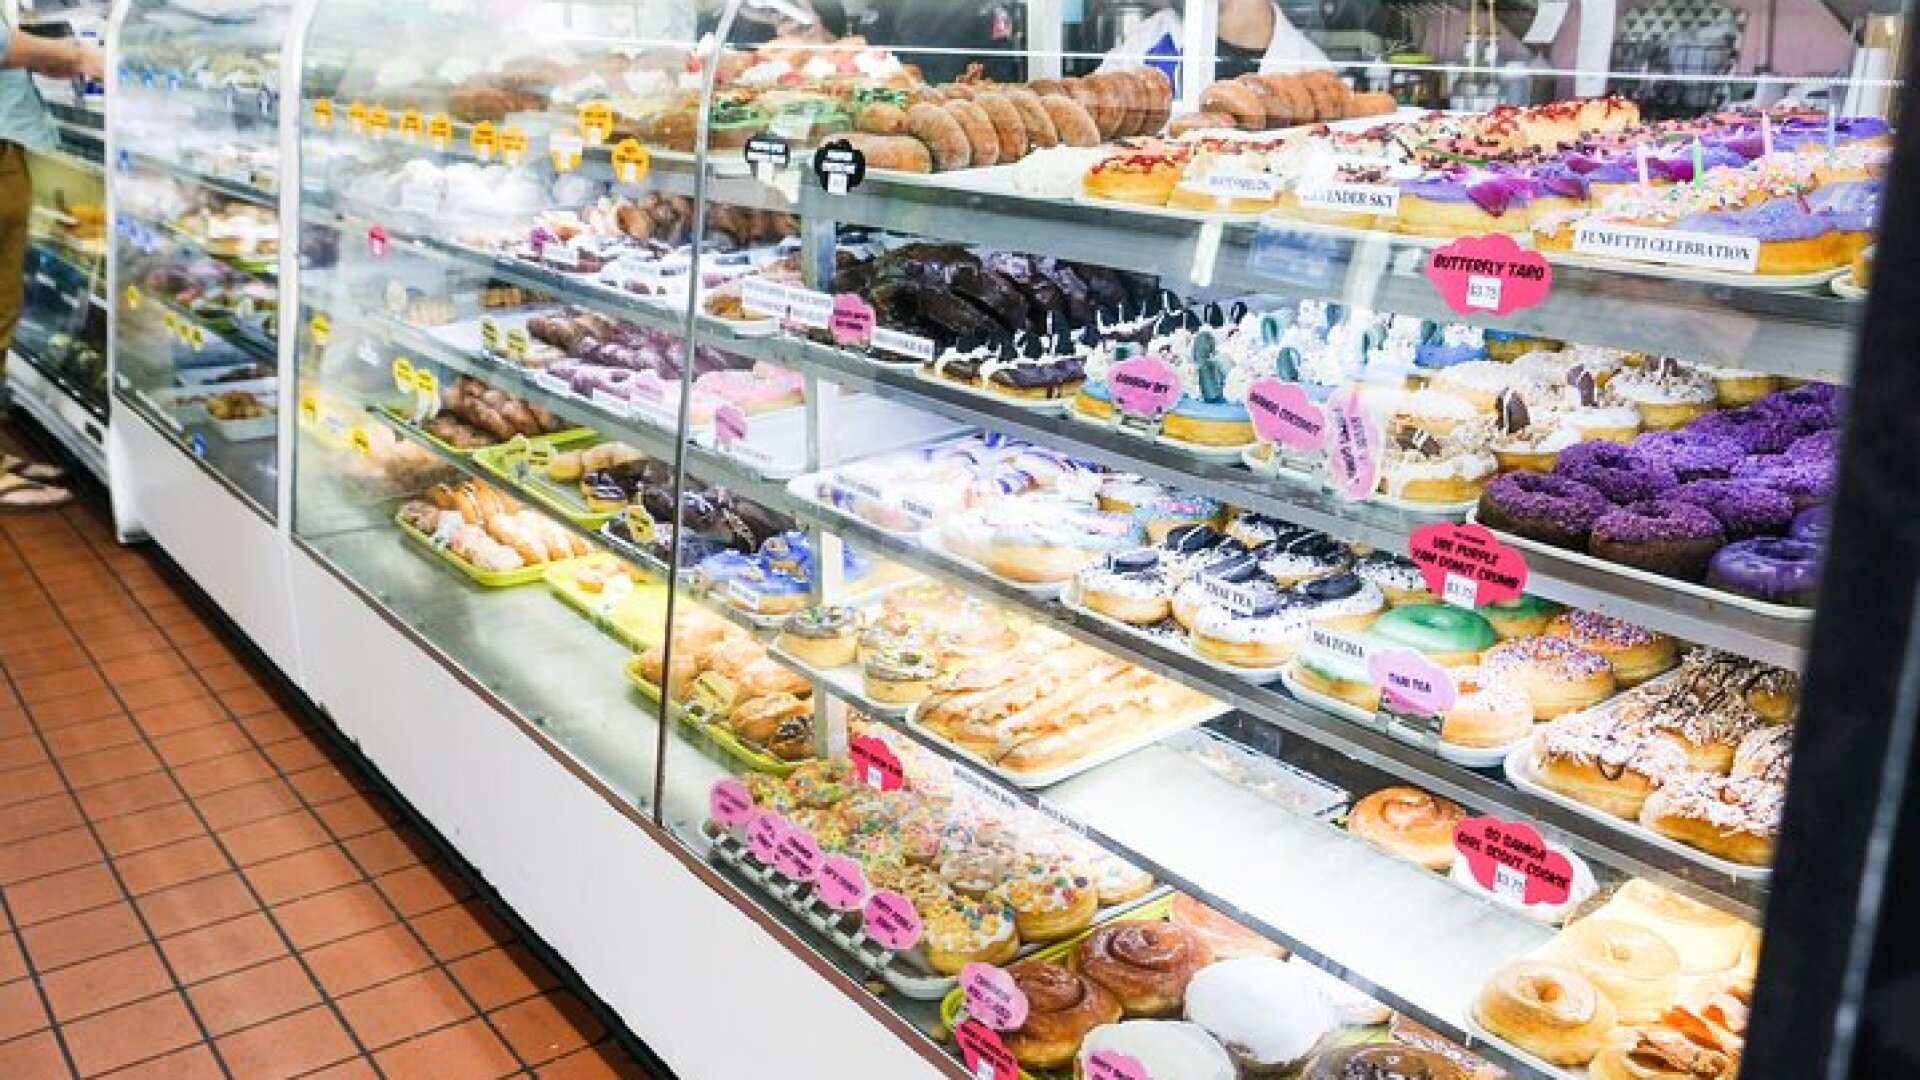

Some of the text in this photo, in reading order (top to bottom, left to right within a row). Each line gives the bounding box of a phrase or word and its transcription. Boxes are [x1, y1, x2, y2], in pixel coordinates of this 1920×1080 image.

[1580, 229, 1751, 260] FUNFETTI CELEBRATION
[1433, 253, 1545, 281] BUTTERFLY TARO
[1456, 543, 1499, 567] PURPLE
[1313, 630, 1364, 659] MATCHA
[1457, 831, 1571, 890] GIRL SCOUT COOKIE
